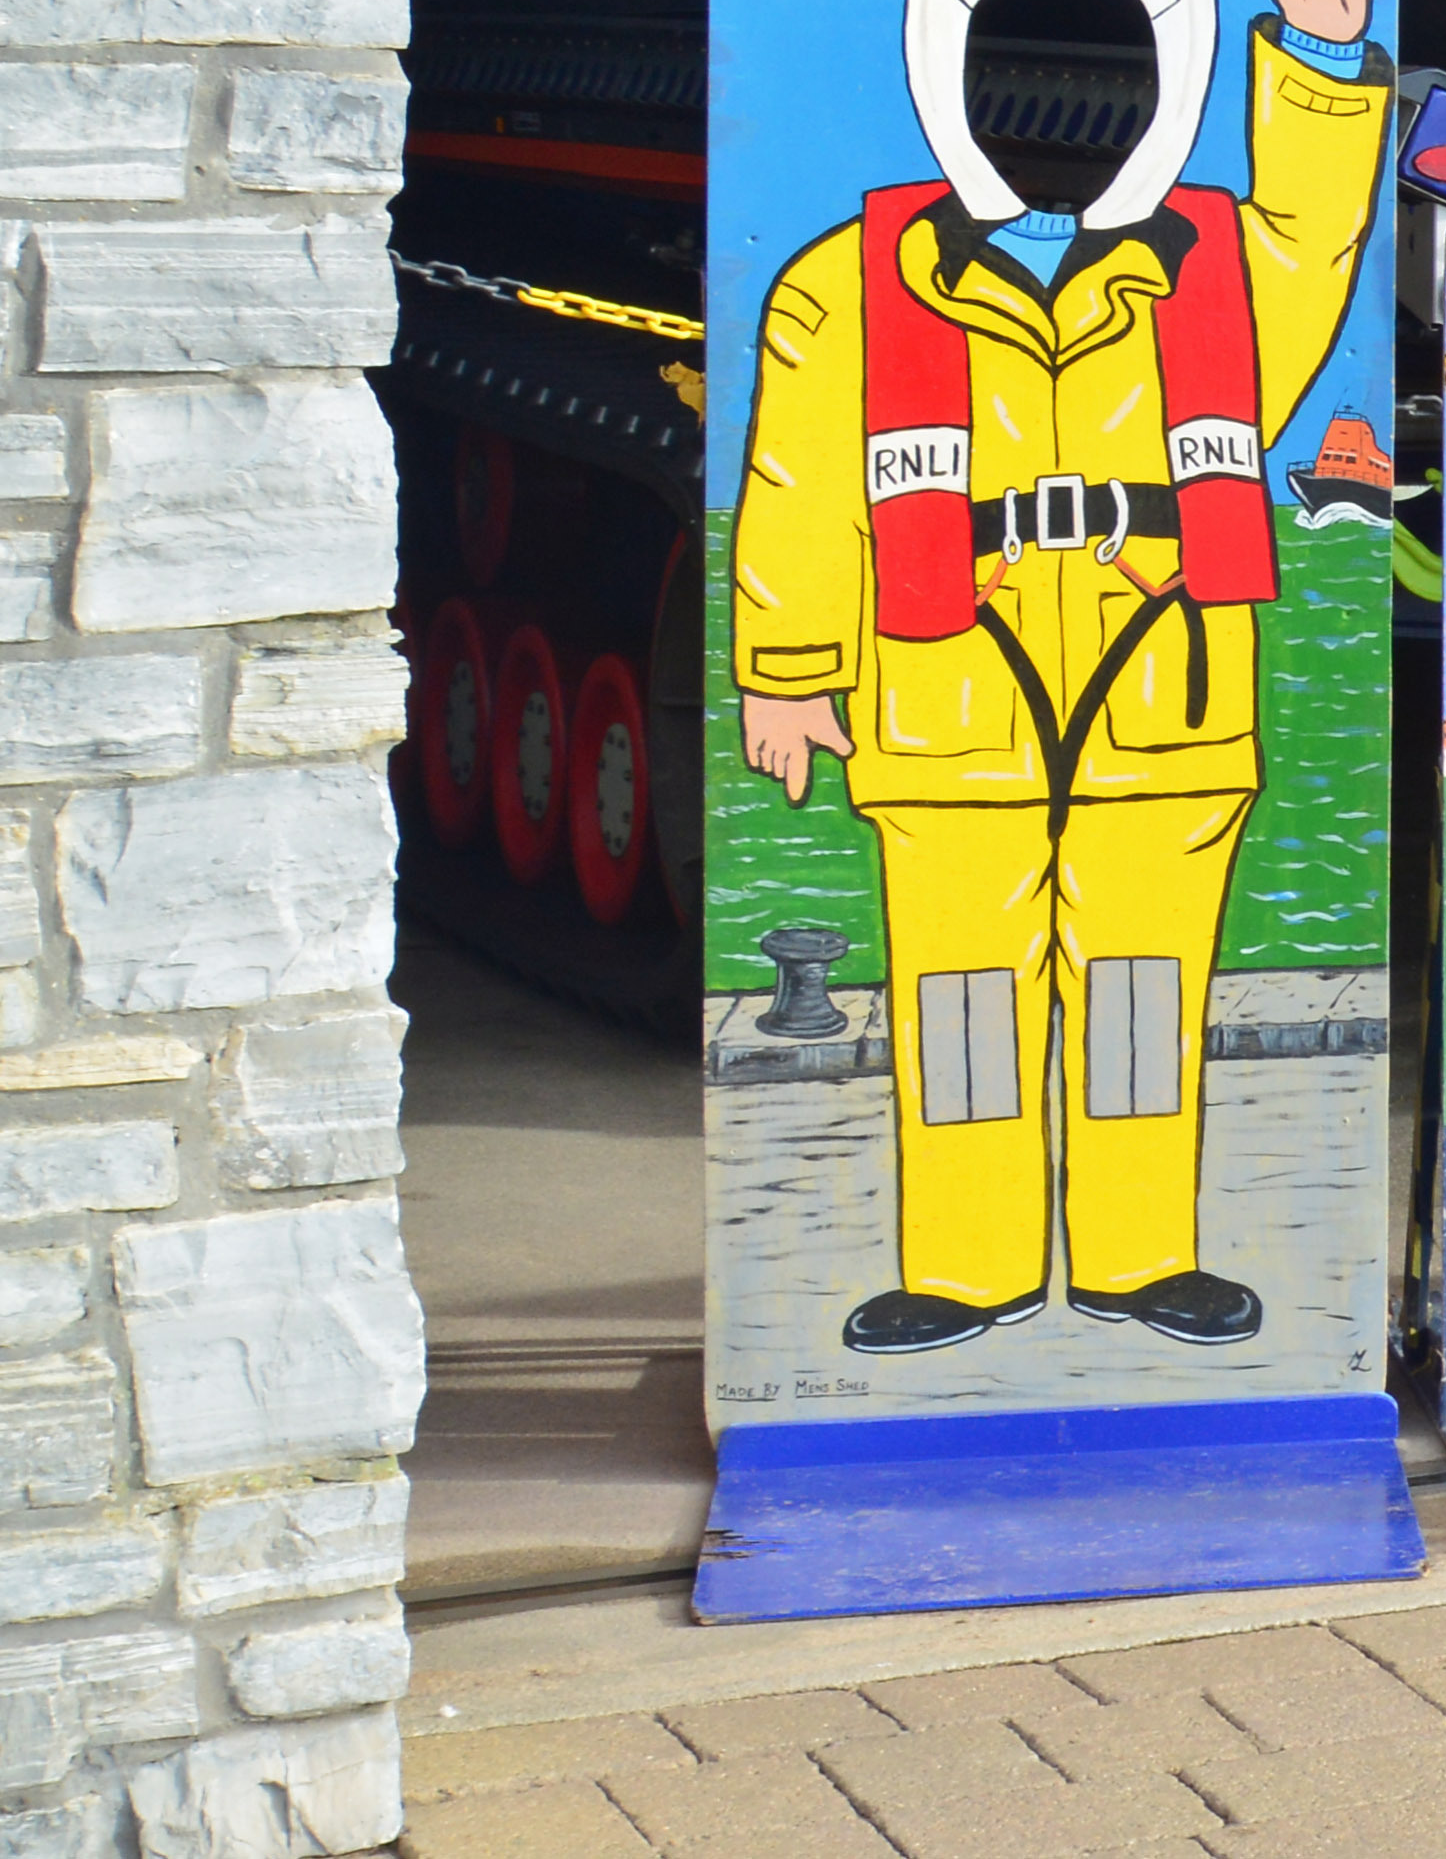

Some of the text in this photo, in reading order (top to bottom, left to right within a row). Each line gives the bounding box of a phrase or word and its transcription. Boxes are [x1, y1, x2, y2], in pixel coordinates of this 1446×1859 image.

[874, 442, 960, 493] RNLI
[1176, 436, 1255, 475] RNLI
[715, 1378, 869, 1398] MADE BY MENS SHED
